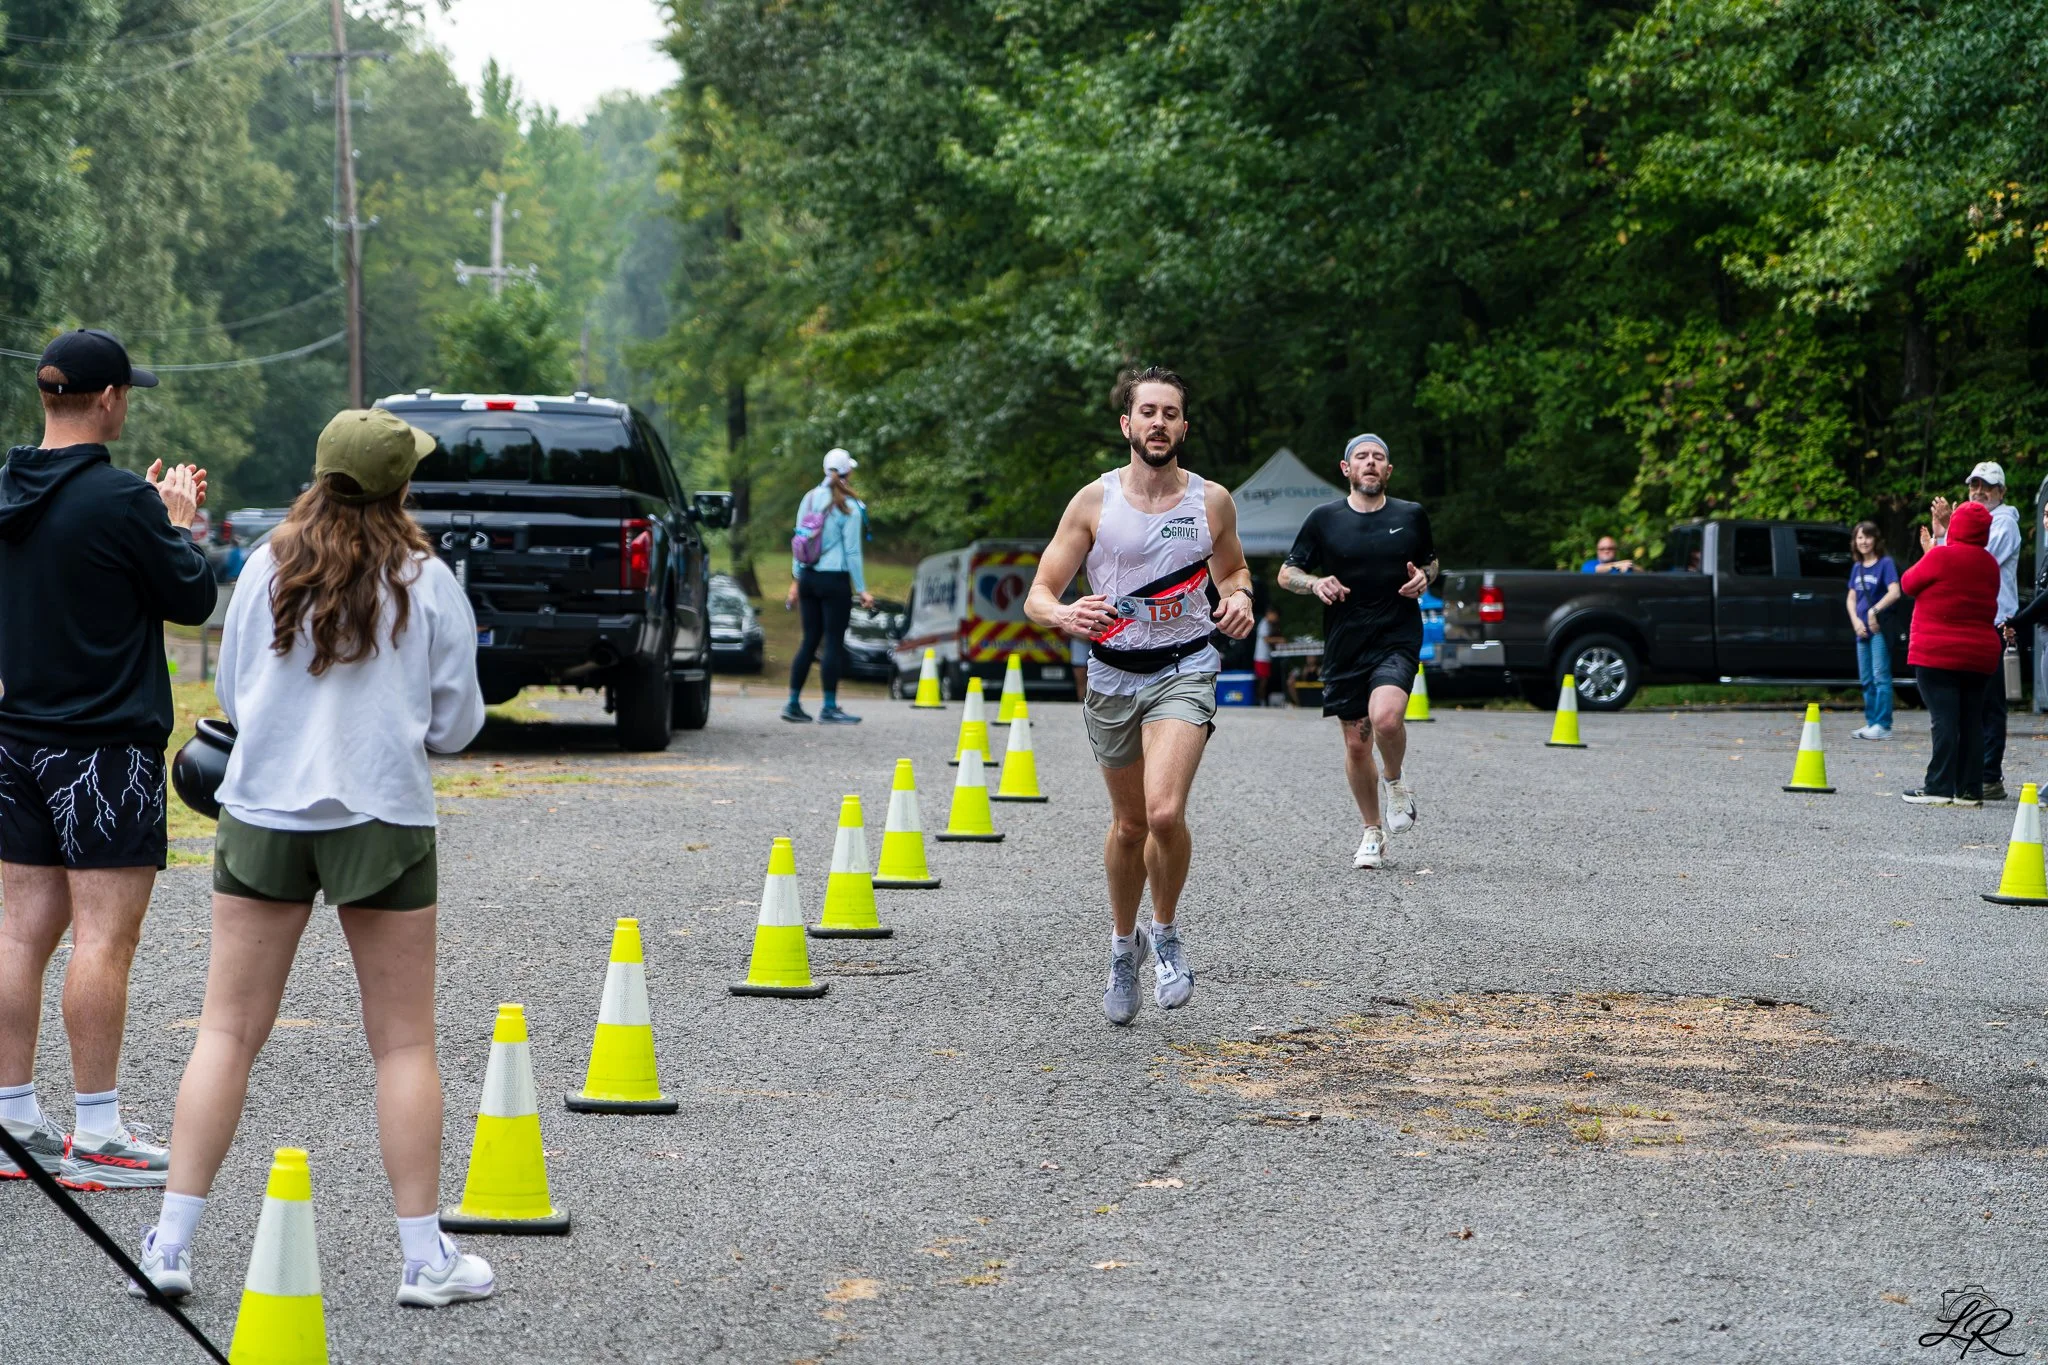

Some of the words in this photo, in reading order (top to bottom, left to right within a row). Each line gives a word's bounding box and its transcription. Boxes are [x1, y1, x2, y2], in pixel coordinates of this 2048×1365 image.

[1171, 526, 1199, 539] GRIVET
[1149, 602, 1182, 621] 150
[80, 1154, 149, 1169] ALTRA
